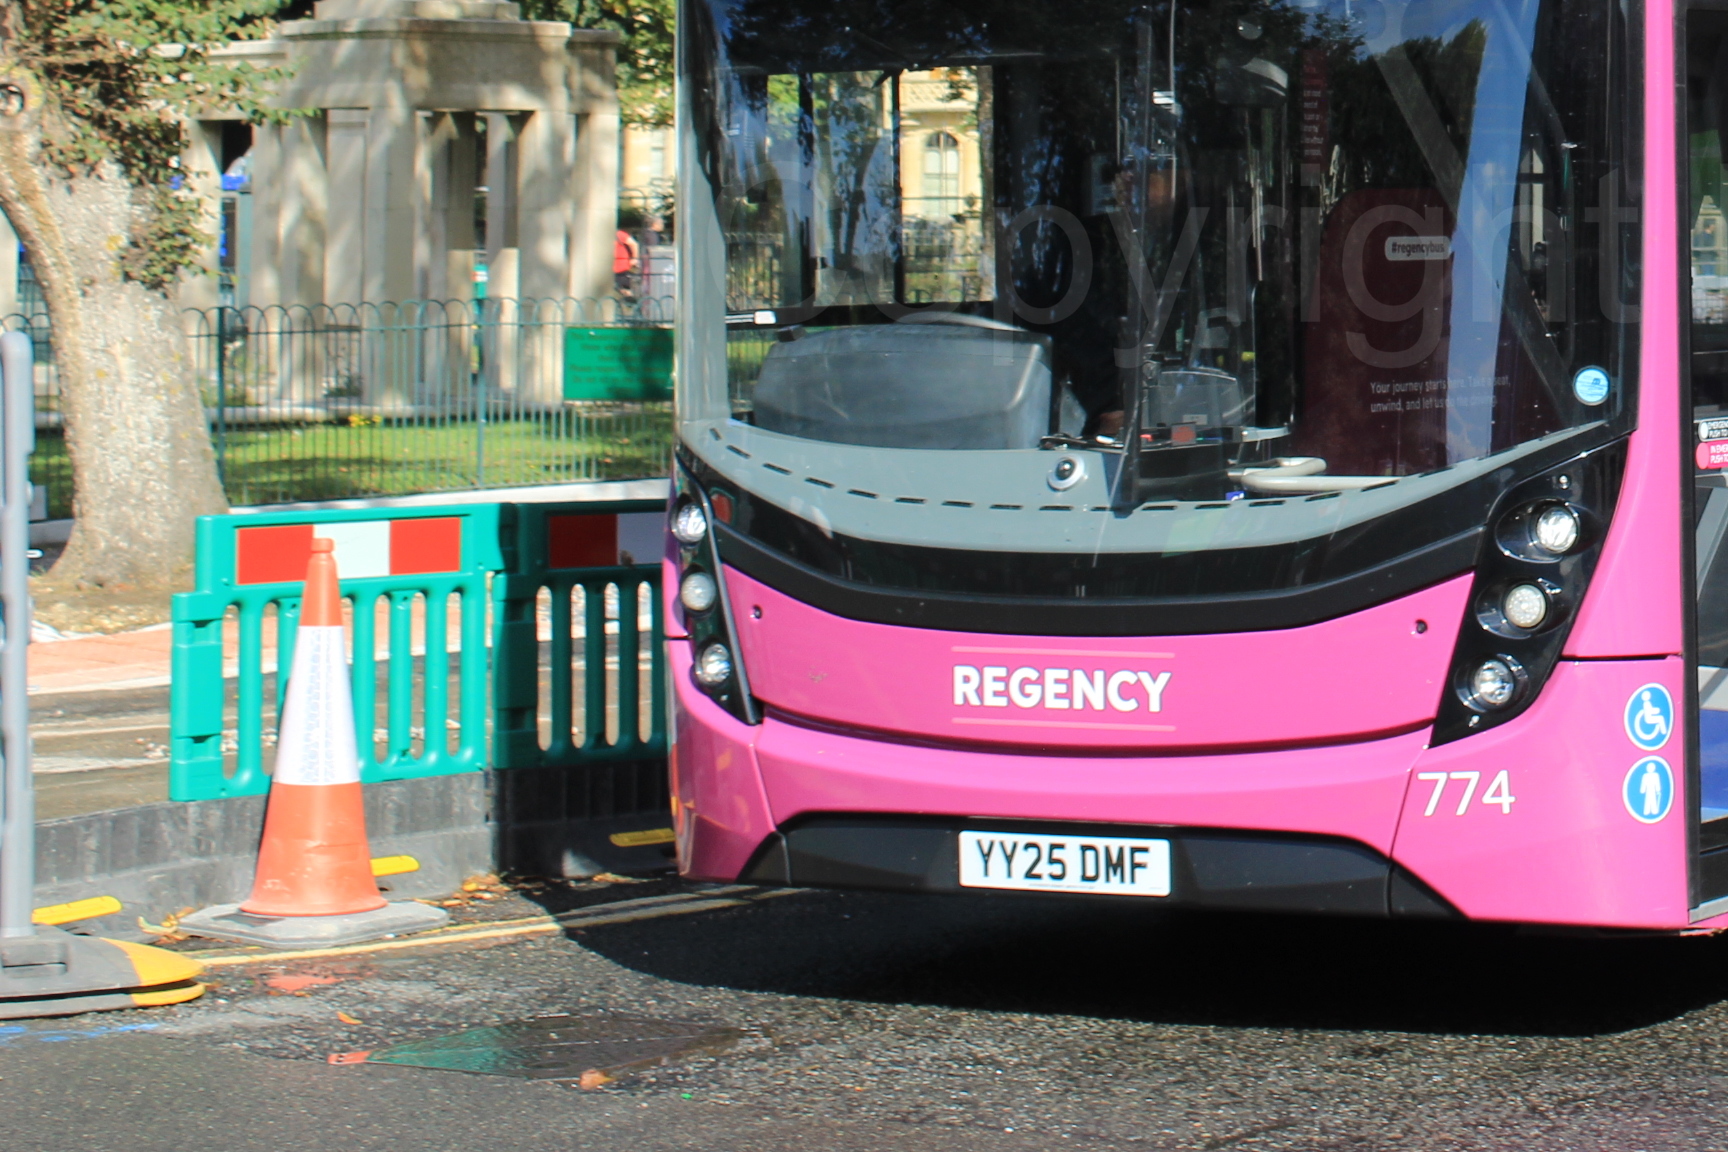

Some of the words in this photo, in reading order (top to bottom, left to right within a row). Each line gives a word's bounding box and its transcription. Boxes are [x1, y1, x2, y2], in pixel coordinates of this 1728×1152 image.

[1391, 241, 1445, 257] #regencybus
[1370, 381, 1390, 394] Your
[1392, 380, 1423, 395] journey
[1425, 379, 1446, 392] starts
[1370, 400, 1404, 413] unwind,
[1406, 399, 1420, 410] and
[1422, 398, 1433, 409] let
[1435, 401, 1444, 409] us
[953, 664, 1173, 713] REGENCY
[1417, 769, 1517, 817] 774
[976, 838, 1067, 881] YY25
[1080, 843, 1151, 885] DMF
